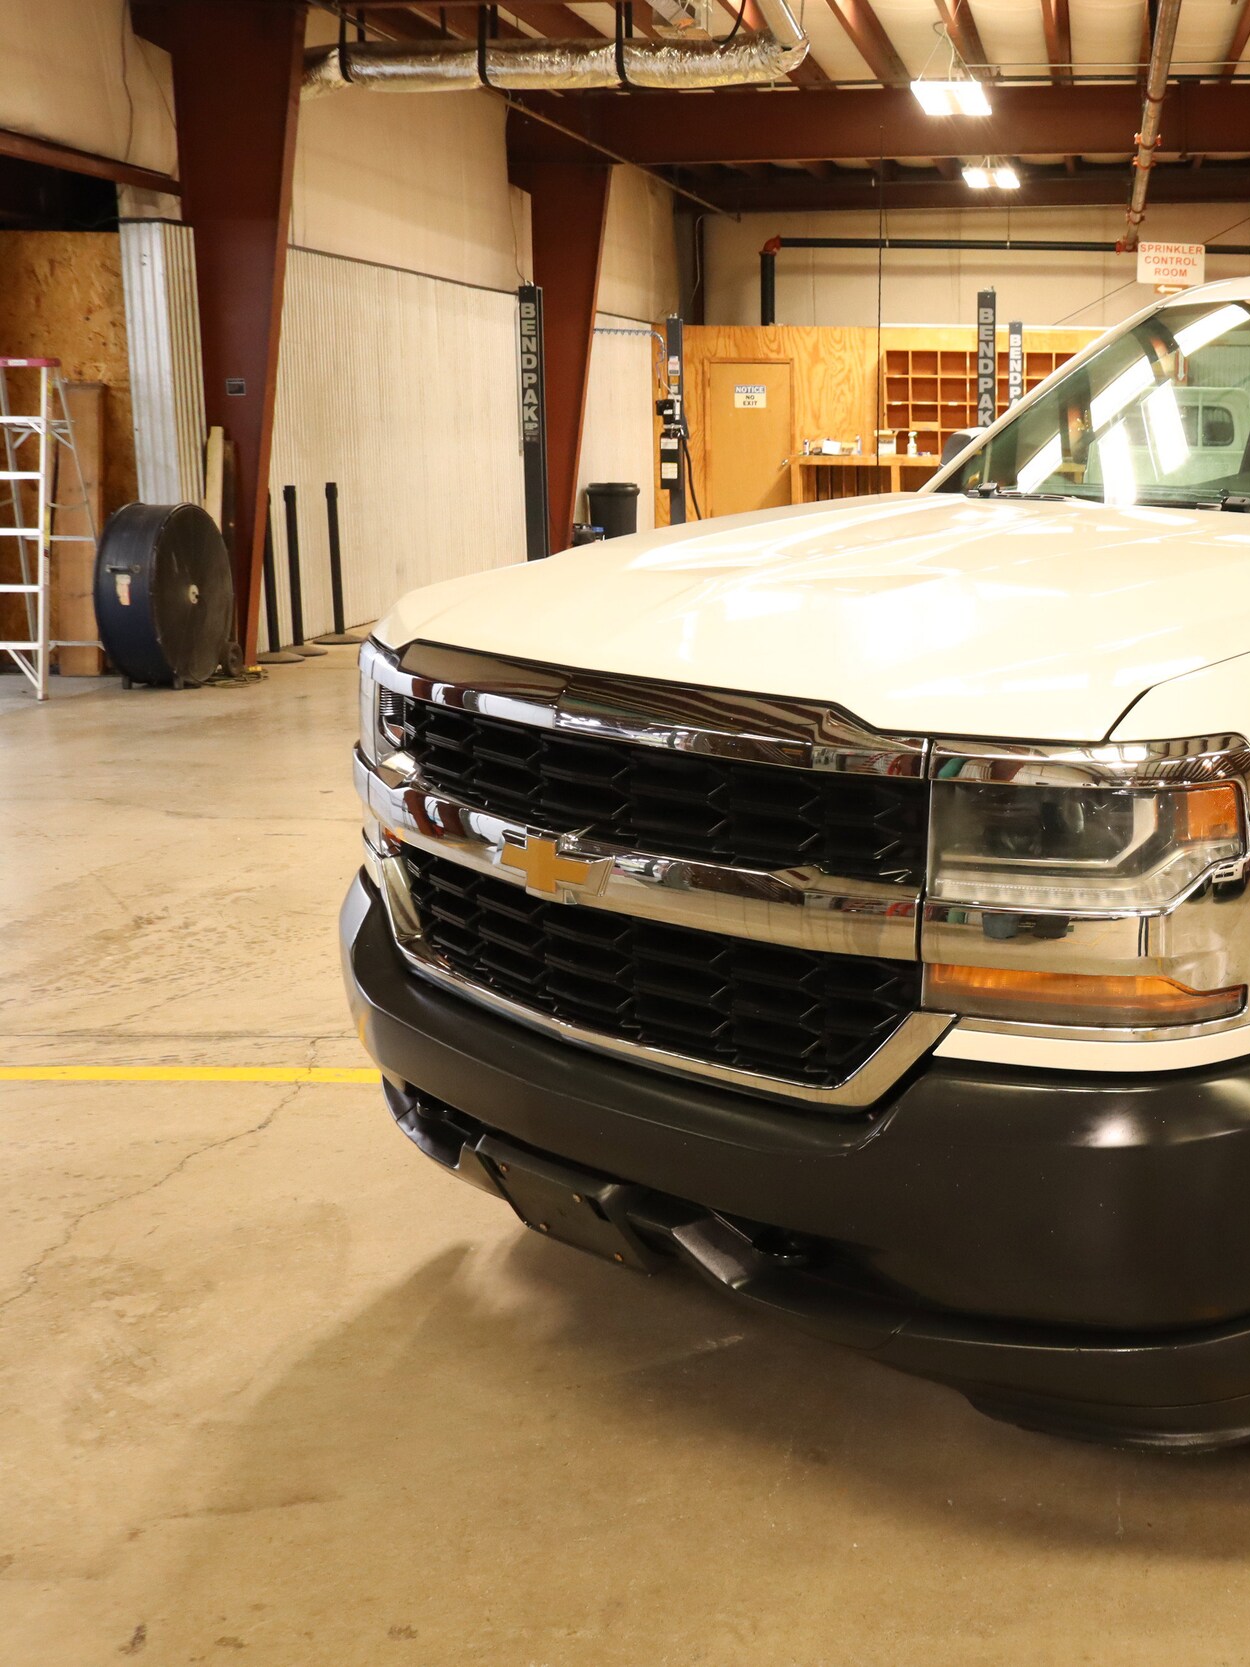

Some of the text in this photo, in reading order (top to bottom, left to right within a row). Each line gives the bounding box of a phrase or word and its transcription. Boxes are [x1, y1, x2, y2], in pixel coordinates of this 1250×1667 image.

[1140, 244, 1203, 255] SPRINKLER
[1144, 255, 1197, 266] CONTROL
[1154, 267, 1188, 277] ROOM
[520, 302, 539, 422] BENDPAK
[978, 307, 995, 426] BENDPAK
